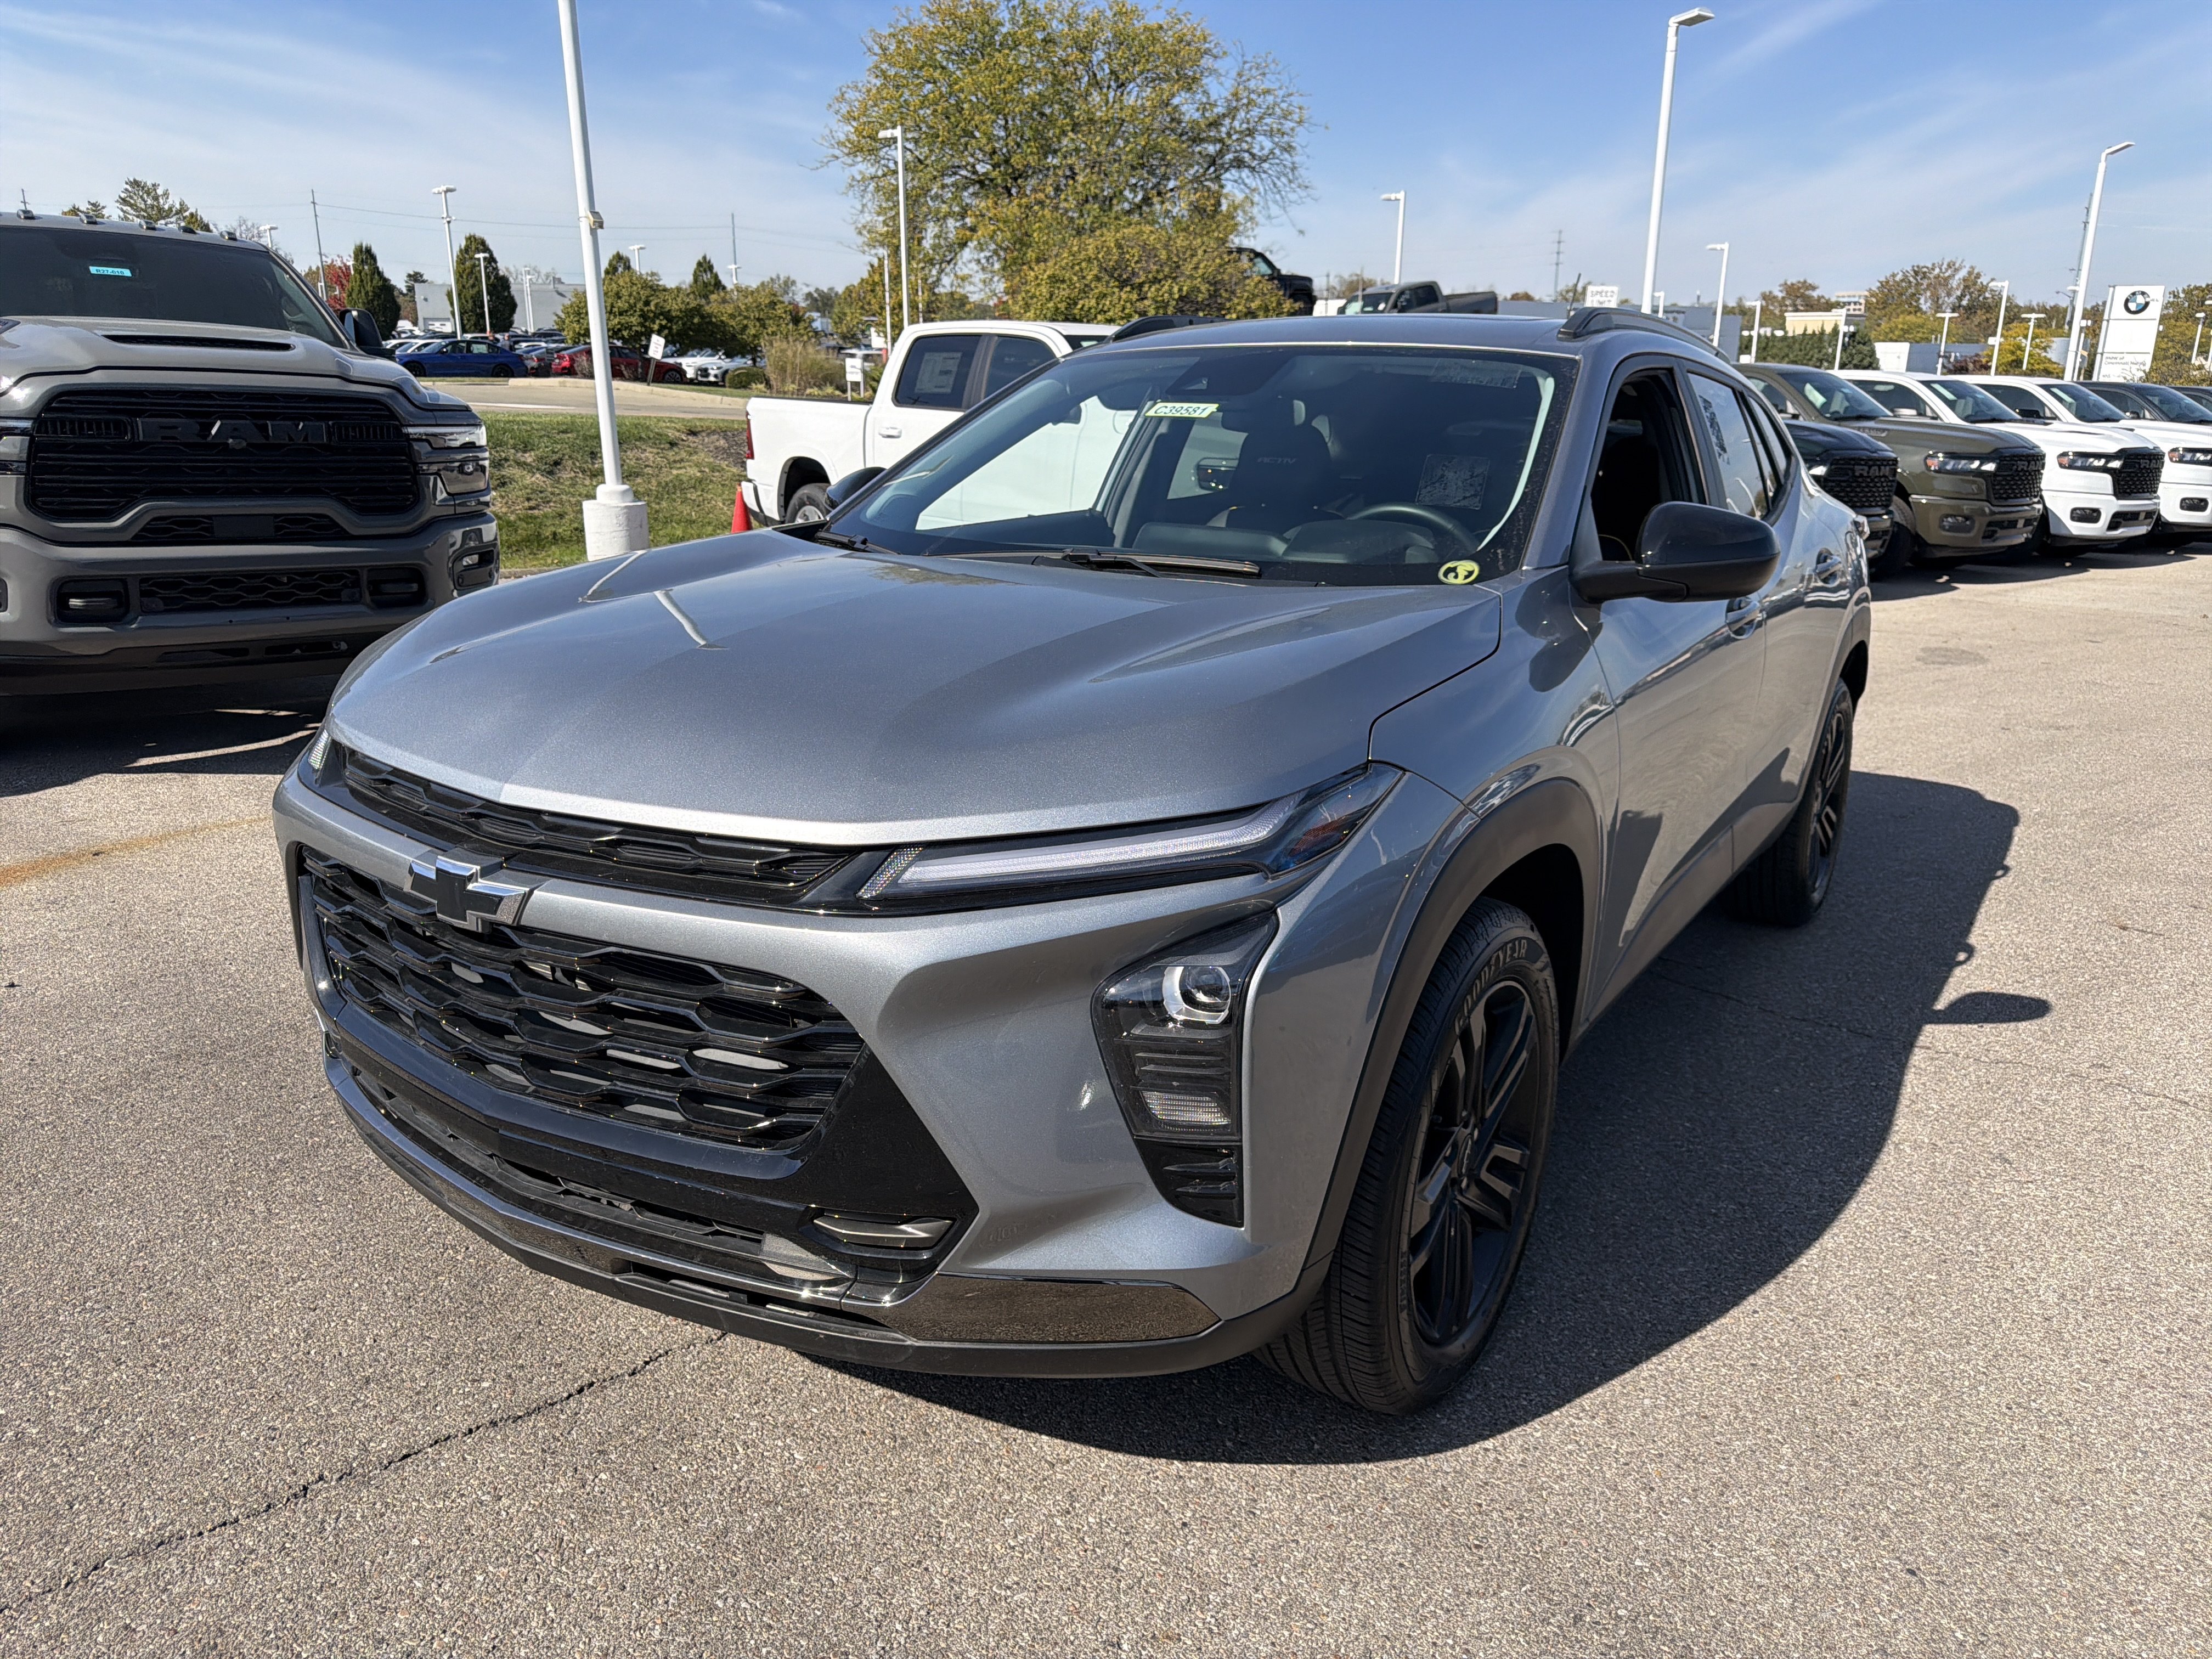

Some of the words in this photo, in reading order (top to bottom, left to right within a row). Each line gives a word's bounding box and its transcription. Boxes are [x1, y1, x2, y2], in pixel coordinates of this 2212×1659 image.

[1590, 290, 1615, 298] SPEED
[1154, 405, 1209, 416] C39581
[137, 417, 328, 443] RAM
[1257, 456, 1297, 465] ACTIV
[1854, 465, 1890, 477] RAM
[1455, 939, 1528, 1036] GOODYEAR
